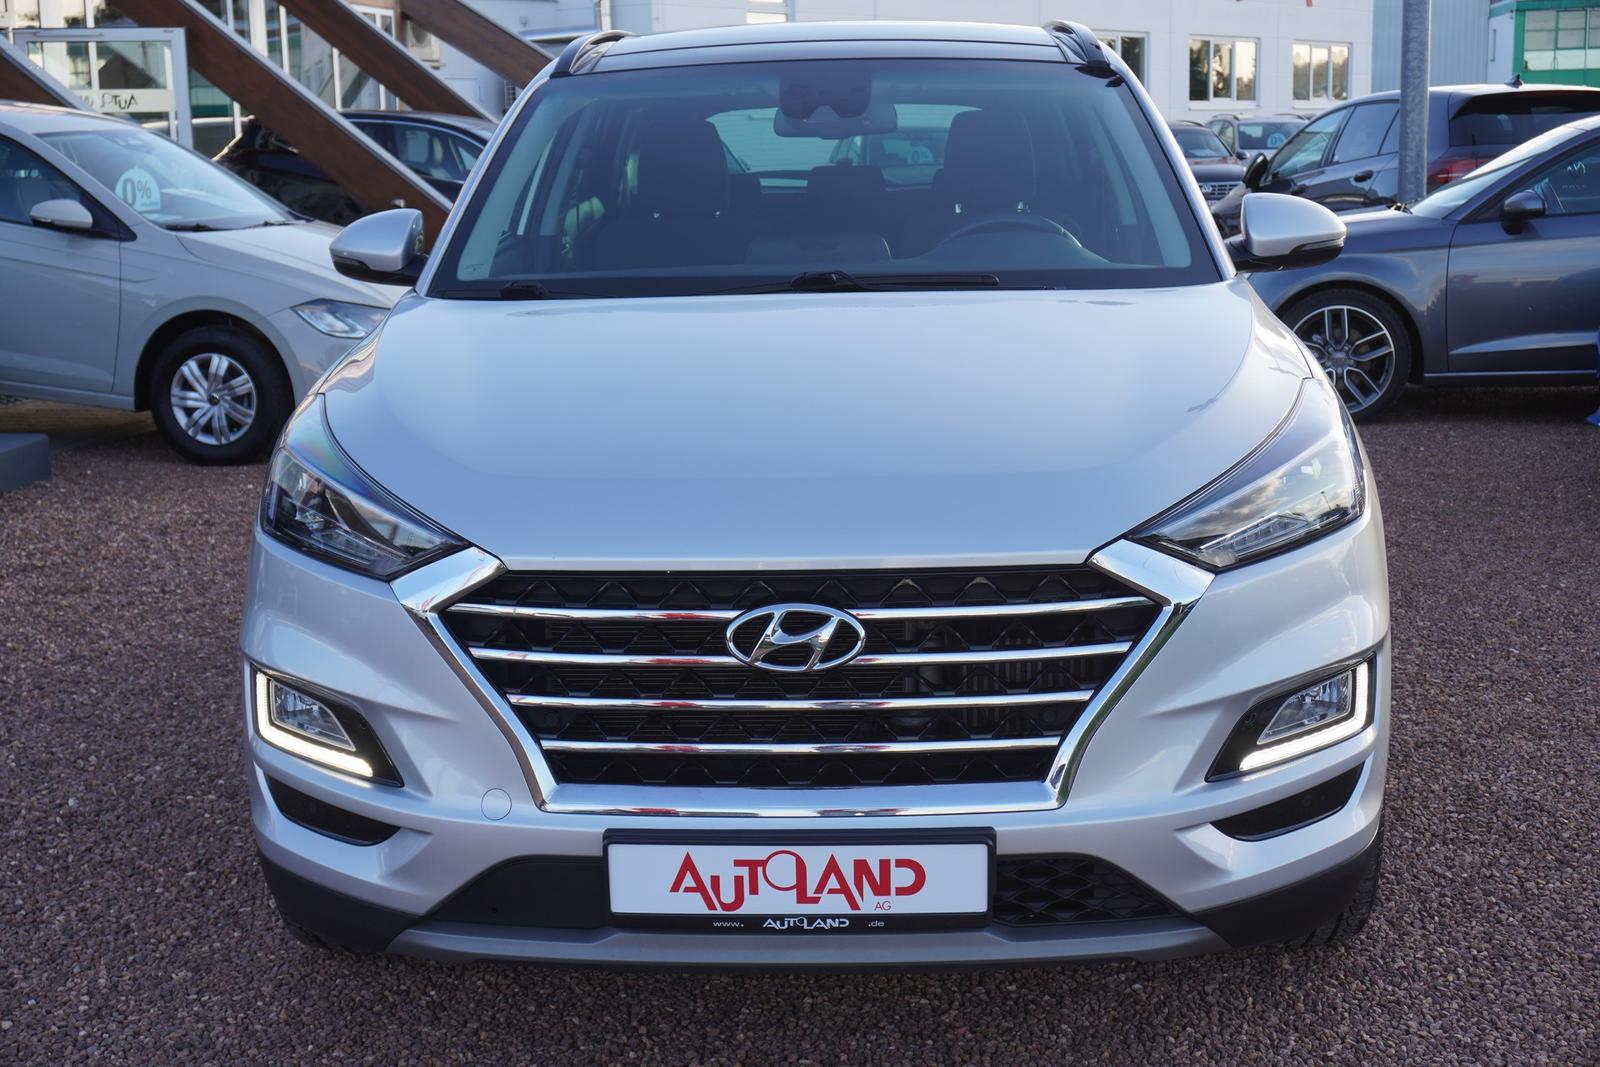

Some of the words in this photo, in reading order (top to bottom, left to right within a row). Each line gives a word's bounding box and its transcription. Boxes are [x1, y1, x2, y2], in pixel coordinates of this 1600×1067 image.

[122, 178, 152, 207] 0%
[669, 849, 926, 912] AUTOLAND
[874, 900, 892, 911] AG
[712, 919, 744, 928] www.
[762, 916, 850, 930] AUTOLAND
[867, 919, 885, 928] .de
